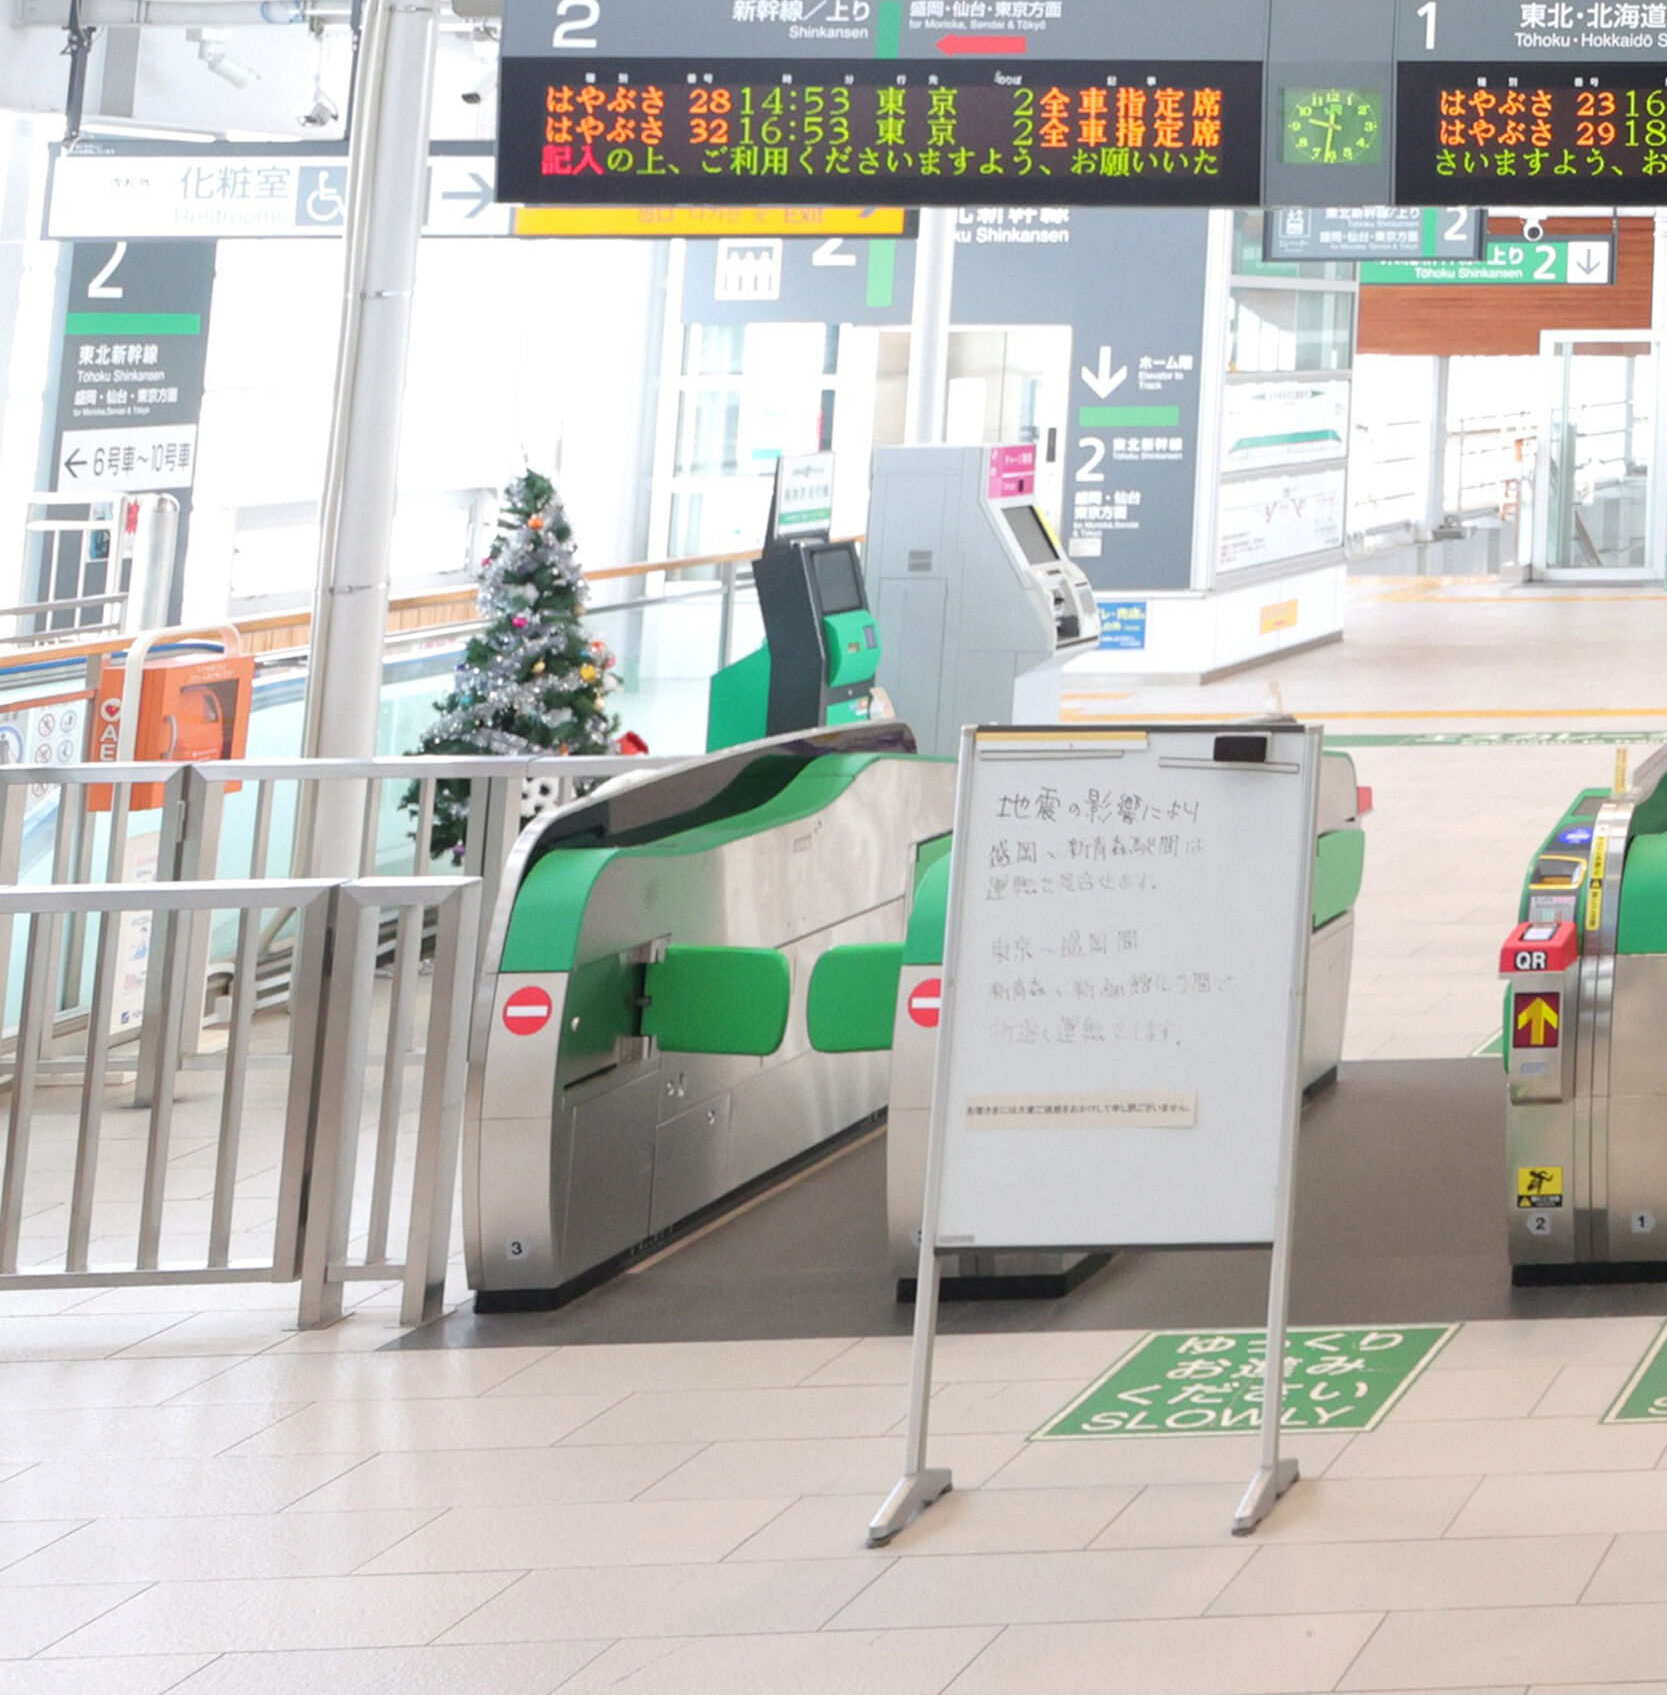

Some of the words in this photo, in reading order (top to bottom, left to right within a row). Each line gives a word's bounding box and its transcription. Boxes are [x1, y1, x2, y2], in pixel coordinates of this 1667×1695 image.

[910, 0, 1062, 20] 盛岡・仙台・東京方面
[789, 24, 869, 39] Shinkansen
[1417, 1, 1438, 49] 1
[546, 88, 665, 115] はやぶさ
[689, 88, 732, 115] 28
[738, 88, 852, 115] 14:53
[1012, 88, 1035, 115] 2
[1038, 88, 1222, 115] 全車指定席
[1440, 90, 1554, 117] はやぶさ
[1576, 90, 1617, 117] 23
[546, 119, 665, 146] はやぶさ
[689, 119, 732, 146] 32
[738, 119, 852, 146] 16:53
[1012, 119, 1035, 146] 2
[1038, 119, 1222, 146] 全車指定席
[1440, 120, 1554, 147] はやぶさ
[1576, 120, 1617, 147] 29
[180, 165, 291, 200] 化粧室
[976, 226, 1070, 243] Shinkansen
[1443, 207, 1467, 241] 2
[1458, 266, 1523, 280] Shinkansen
[1532, 245, 1557, 280] 2
[78, 344, 158, 366] 東北新幹線
[113, 368, 166, 383] Shinkansen
[1075, 437, 1107, 482] 2
[996, 786, 1200, 825] 地震の影響により
[1515, 951, 1548, 971] QR
[1535, 1216, 1547, 1230] 2
[1637, 1216, 1645, 1228] 1
[510, 1241, 524, 1256] 3
